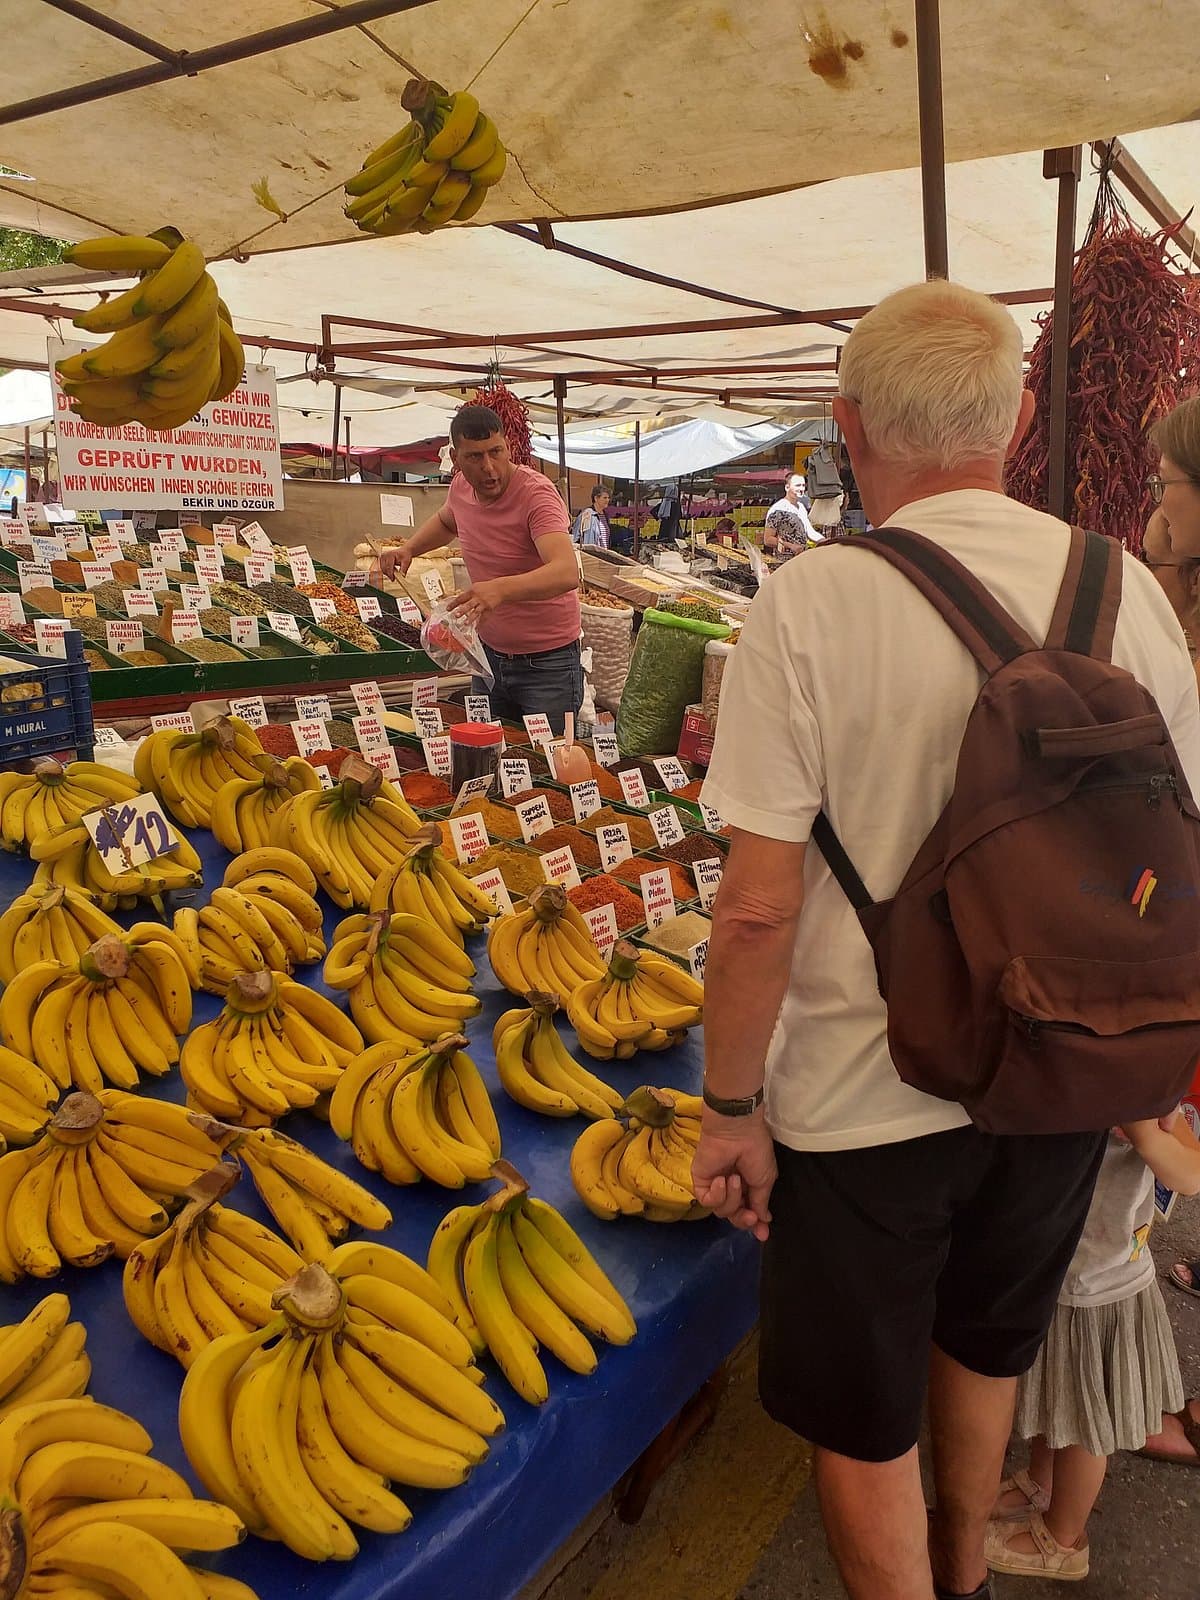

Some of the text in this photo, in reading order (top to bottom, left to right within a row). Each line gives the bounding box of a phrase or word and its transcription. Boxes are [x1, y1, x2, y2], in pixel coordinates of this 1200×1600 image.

[251, 392, 271, 408] WIR
[212, 407, 275, 433] GEWÜRZE,
[107, 426, 122, 441] UND
[123, 425, 145, 442] SEELE
[146, 429, 158, 443] DIE
[158, 429, 173, 445] VOM
[174, 430, 245, 450] LANDWIRTSCHAFTSAMT
[246, 435, 277, 452] STAATLICH
[77, 448, 267, 479] GEPRÜFT WURDEN,
[63, 472, 274, 498] WIR WÜNSCHEN IHNEN SCHÖNE FERIEN
[217, 498, 238, 509] UND
[5, 721, 47, 737] M NURAL
[134, 810, 180, 859] 12
